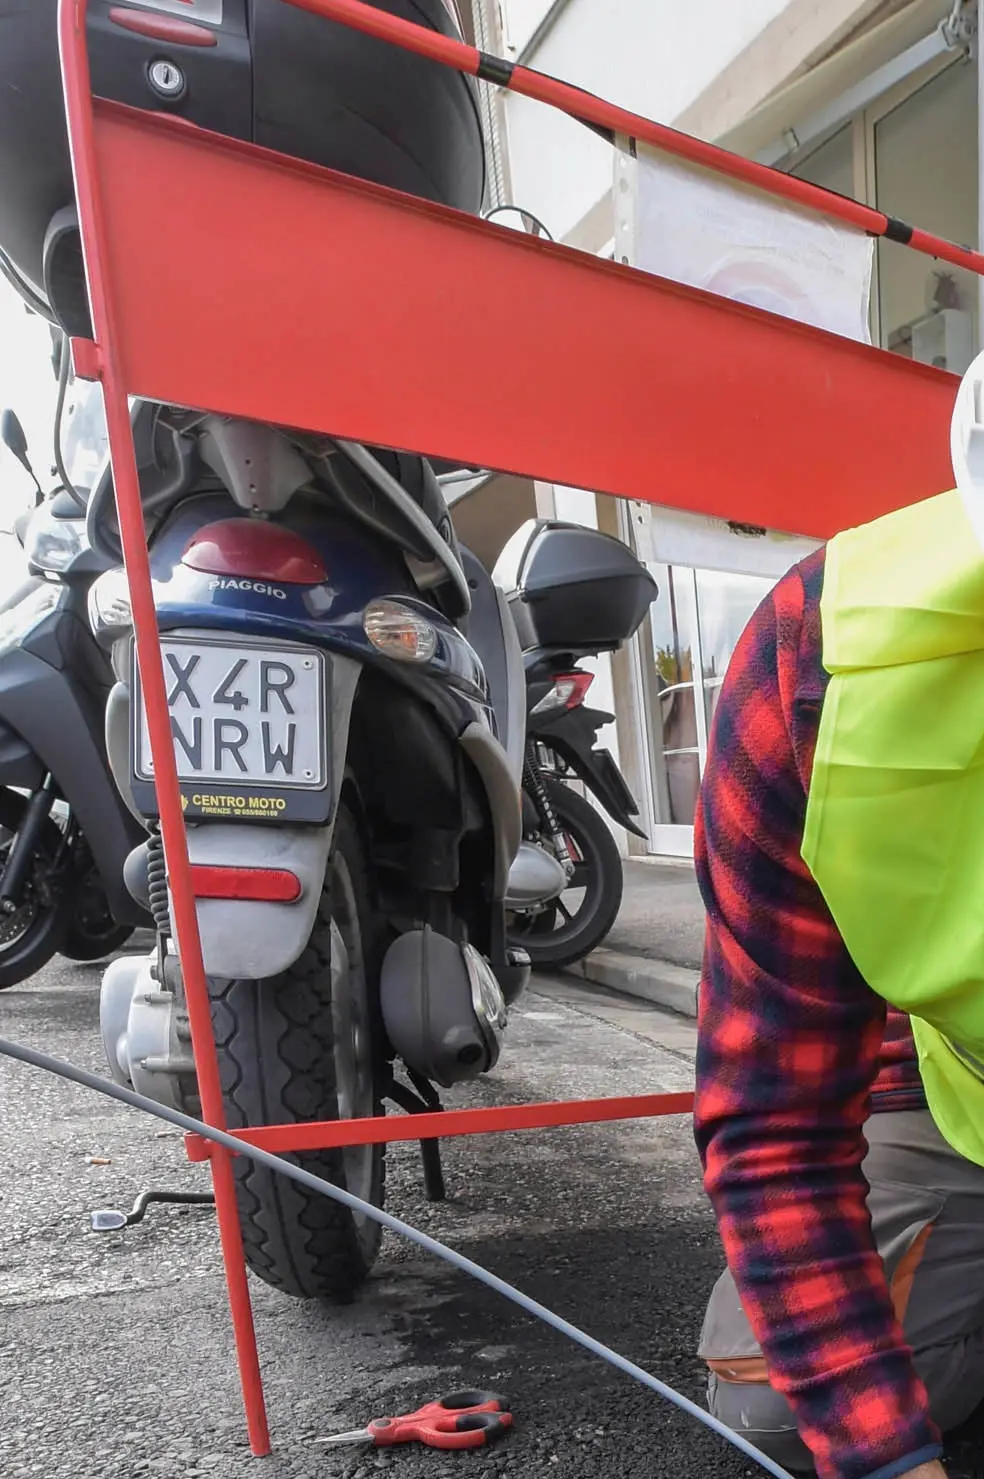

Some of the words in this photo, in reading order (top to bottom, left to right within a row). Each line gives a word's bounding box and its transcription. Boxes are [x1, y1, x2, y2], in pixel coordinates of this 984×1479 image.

[208, 579, 287, 600] PIAGGIO
[165, 653, 296, 715] X4R
[170, 715, 297, 775] NRW
[192, 794, 246, 808] CENTRO
[248, 796, 286, 810] MOTO
